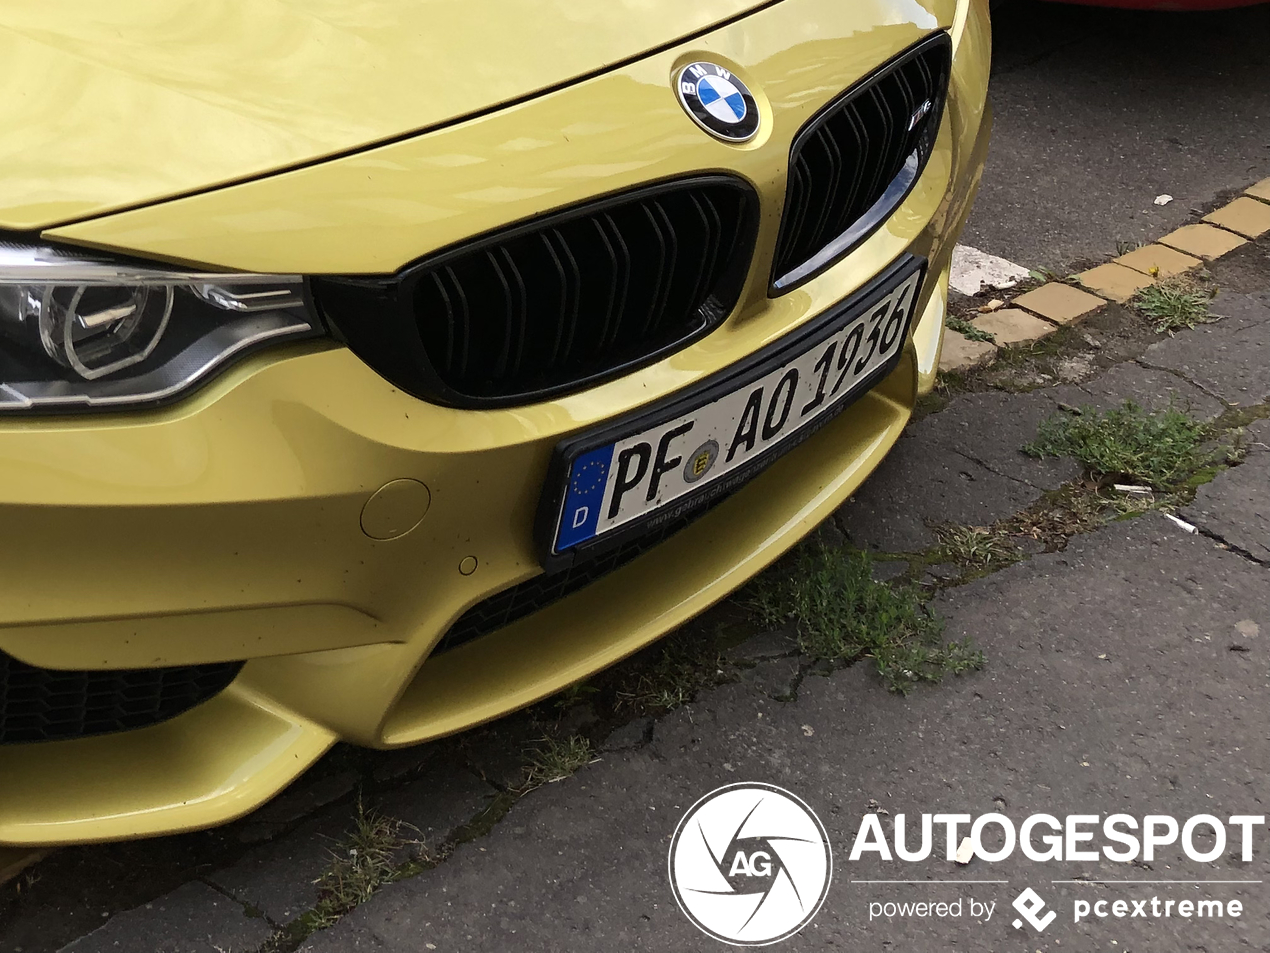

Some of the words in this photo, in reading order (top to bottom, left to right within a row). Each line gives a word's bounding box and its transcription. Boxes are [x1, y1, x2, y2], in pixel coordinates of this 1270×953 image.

[681, 64, 731, 95] BMW
[607, 420, 695, 520] PF
[725, 367, 799, 463] AO
[800, 283, 912, 417] 1936
[572, 506, 588, 529] D
